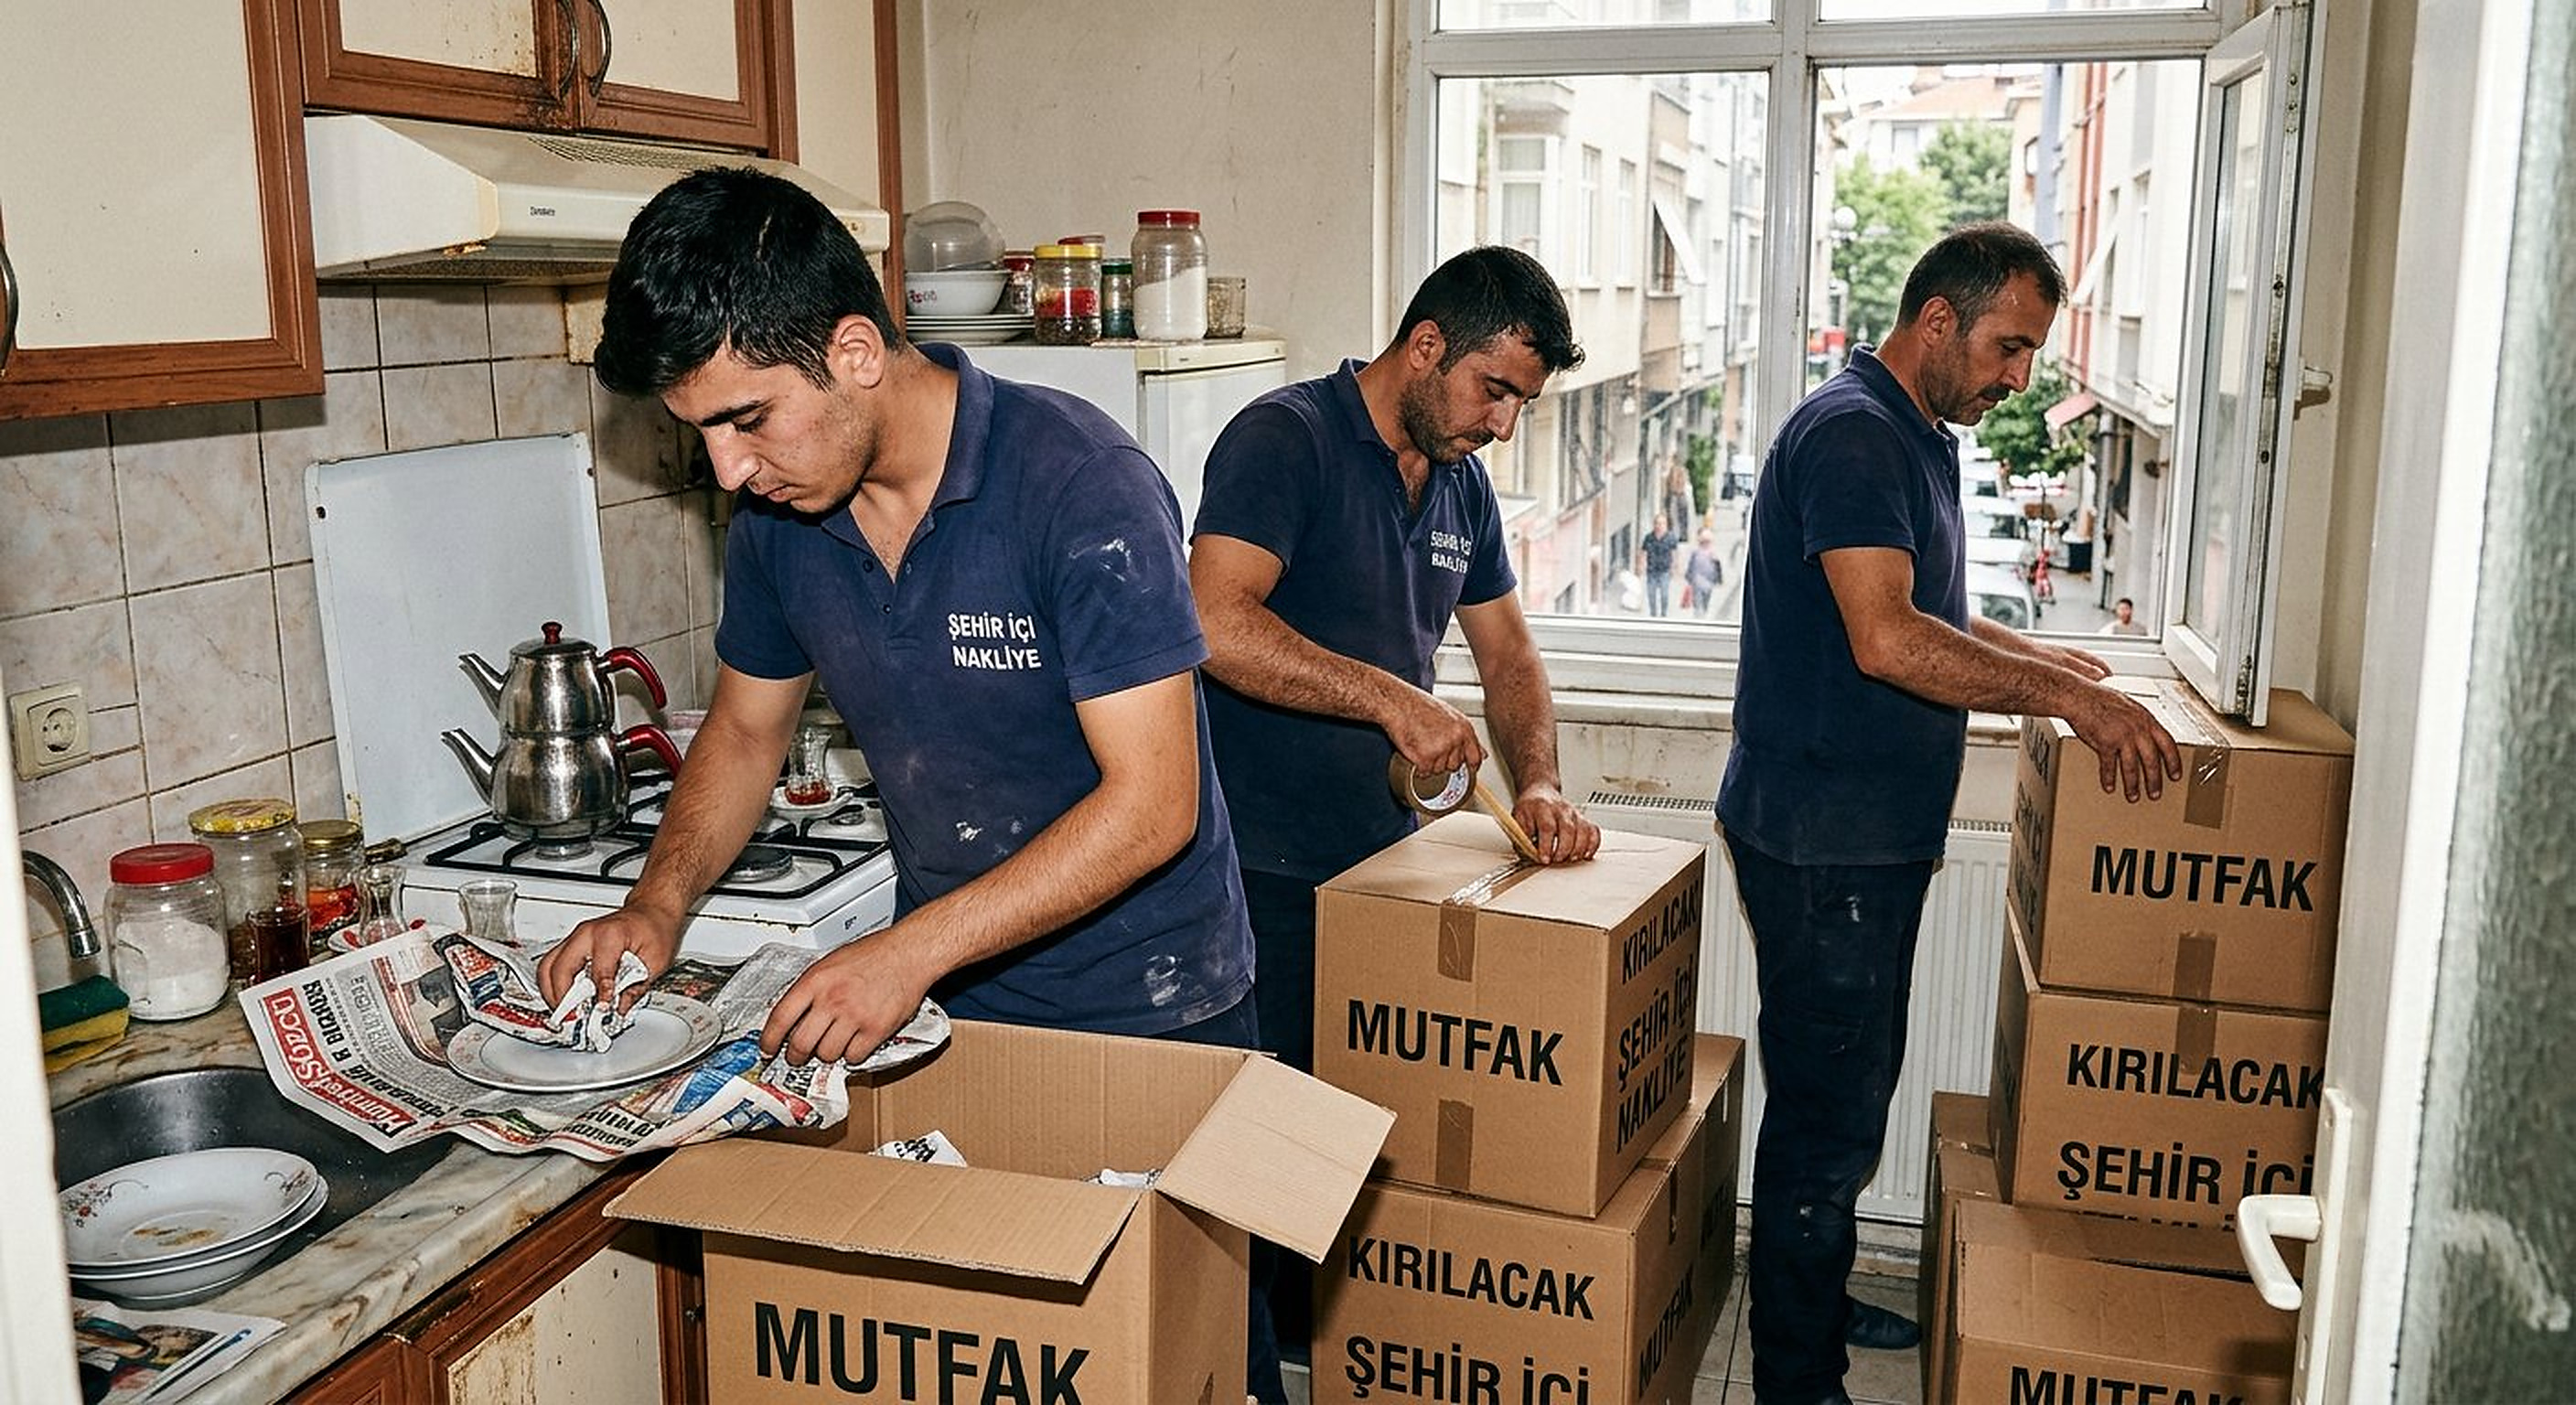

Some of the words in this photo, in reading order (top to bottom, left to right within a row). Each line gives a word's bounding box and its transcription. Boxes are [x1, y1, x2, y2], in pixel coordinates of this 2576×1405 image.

[948, 611, 1005, 640] ŞEHİR
[2091, 844, 2317, 912] MUTFAK
[1622, 879, 1700, 985] KIRILACAK
[1348, 999, 1563, 1086] MUTFAK
[1618, 988, 1669, 1094] ŞEHİR
[2067, 1044, 2324, 1110] KIRILACAK
[2058, 1142, 2222, 1205] ŞEHİR
[1348, 1236, 1595, 1321] KIRILACAK
[755, 1301, 1090, 1405] MUTFAK
[1345, 1335, 1501, 1405] ŞEHİR
[2011, 1366, 2245, 1405] MUT
